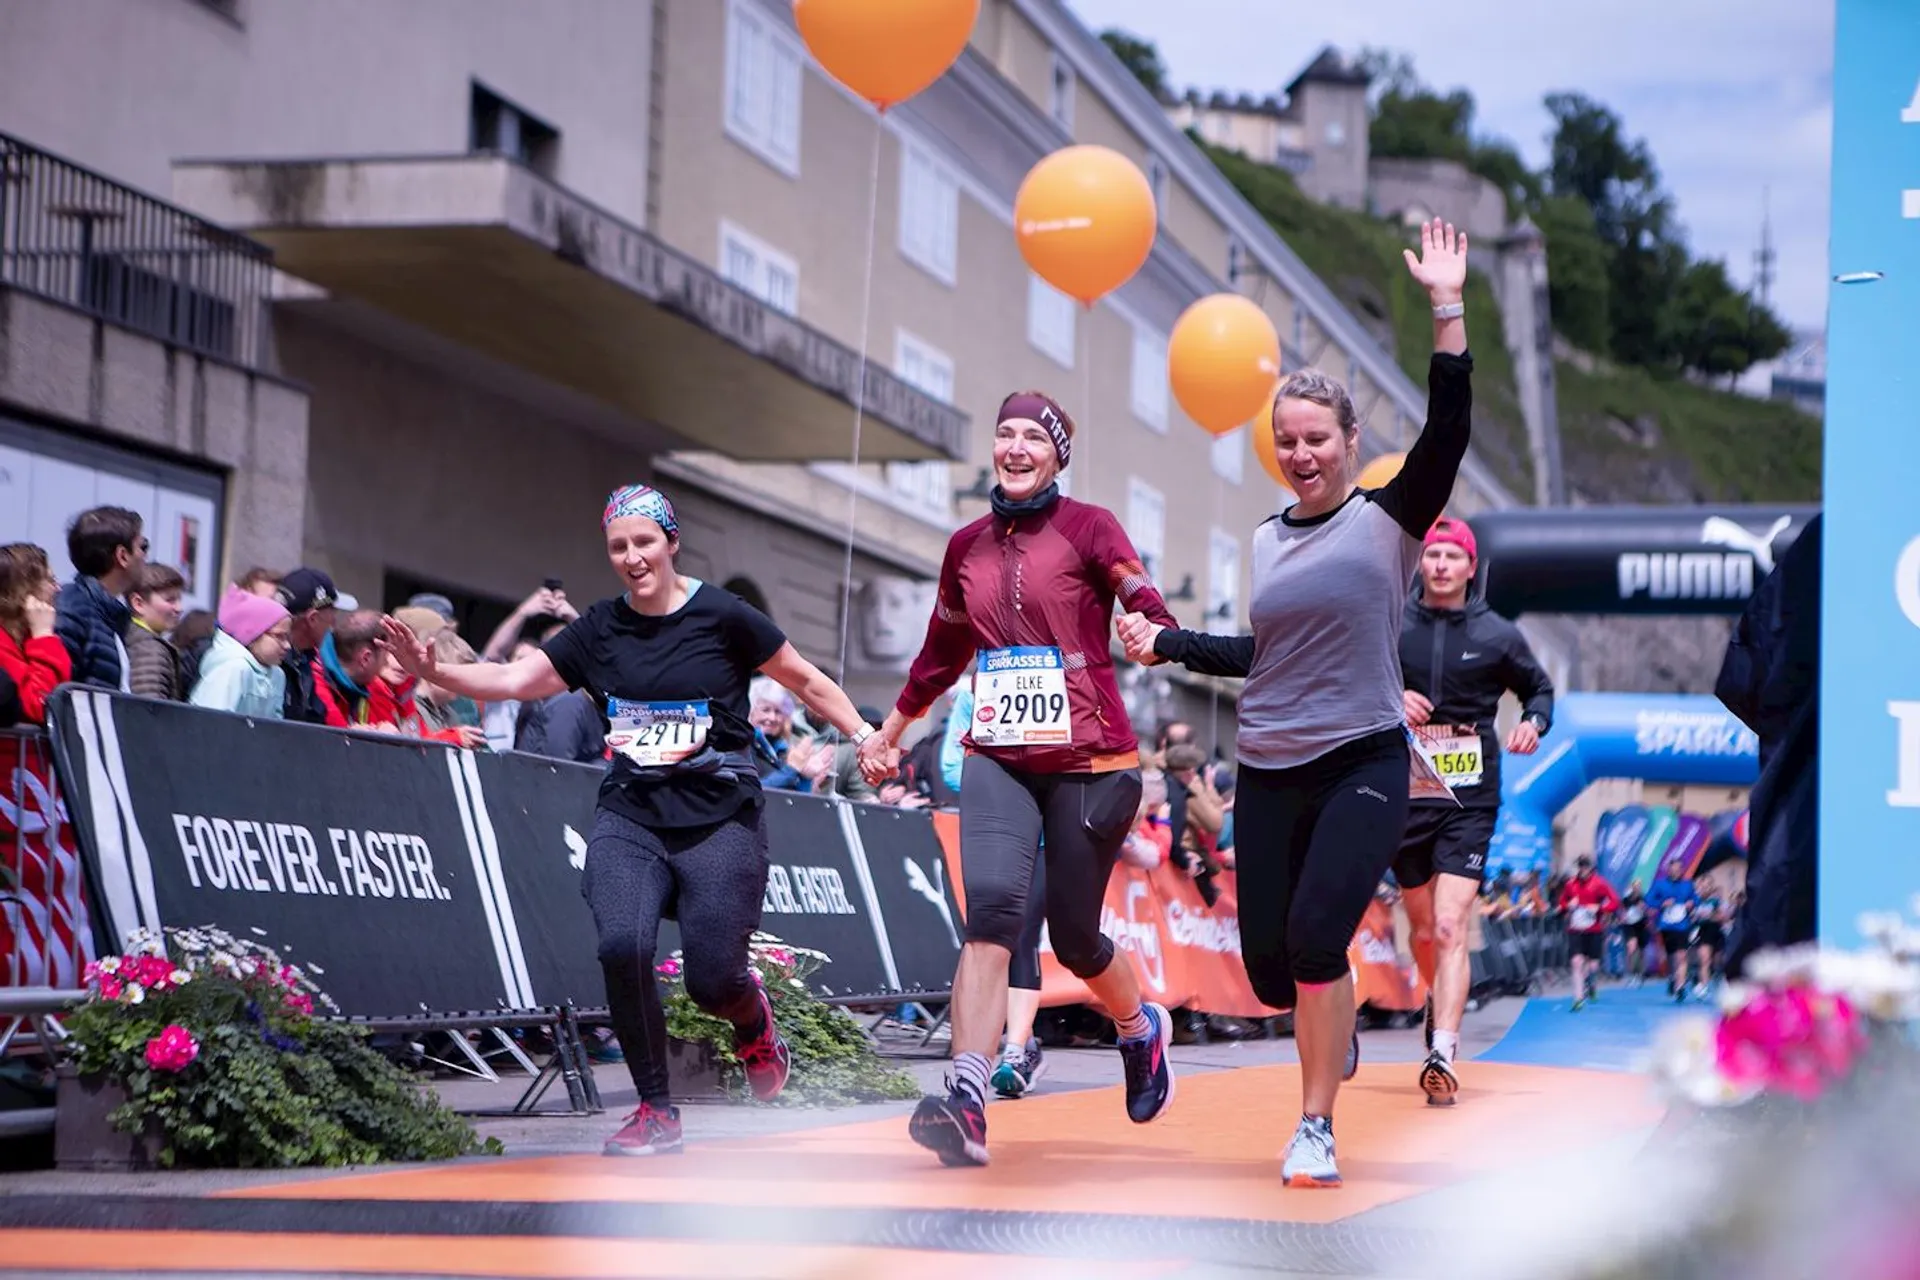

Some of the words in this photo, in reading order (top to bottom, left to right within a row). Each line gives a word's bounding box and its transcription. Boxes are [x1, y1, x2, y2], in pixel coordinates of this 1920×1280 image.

[1618, 552, 1753, 599] PUMA
[986, 655, 1043, 670] SPARKASSE
[1016, 676, 1043, 690] ELKE
[1000, 693, 1064, 724] 2909
[1431, 751, 1478, 774] 1569
[172, 813, 339, 896] FOREVER.
[328, 827, 452, 900] FASTER.
[791, 865, 857, 914] FASTER.
